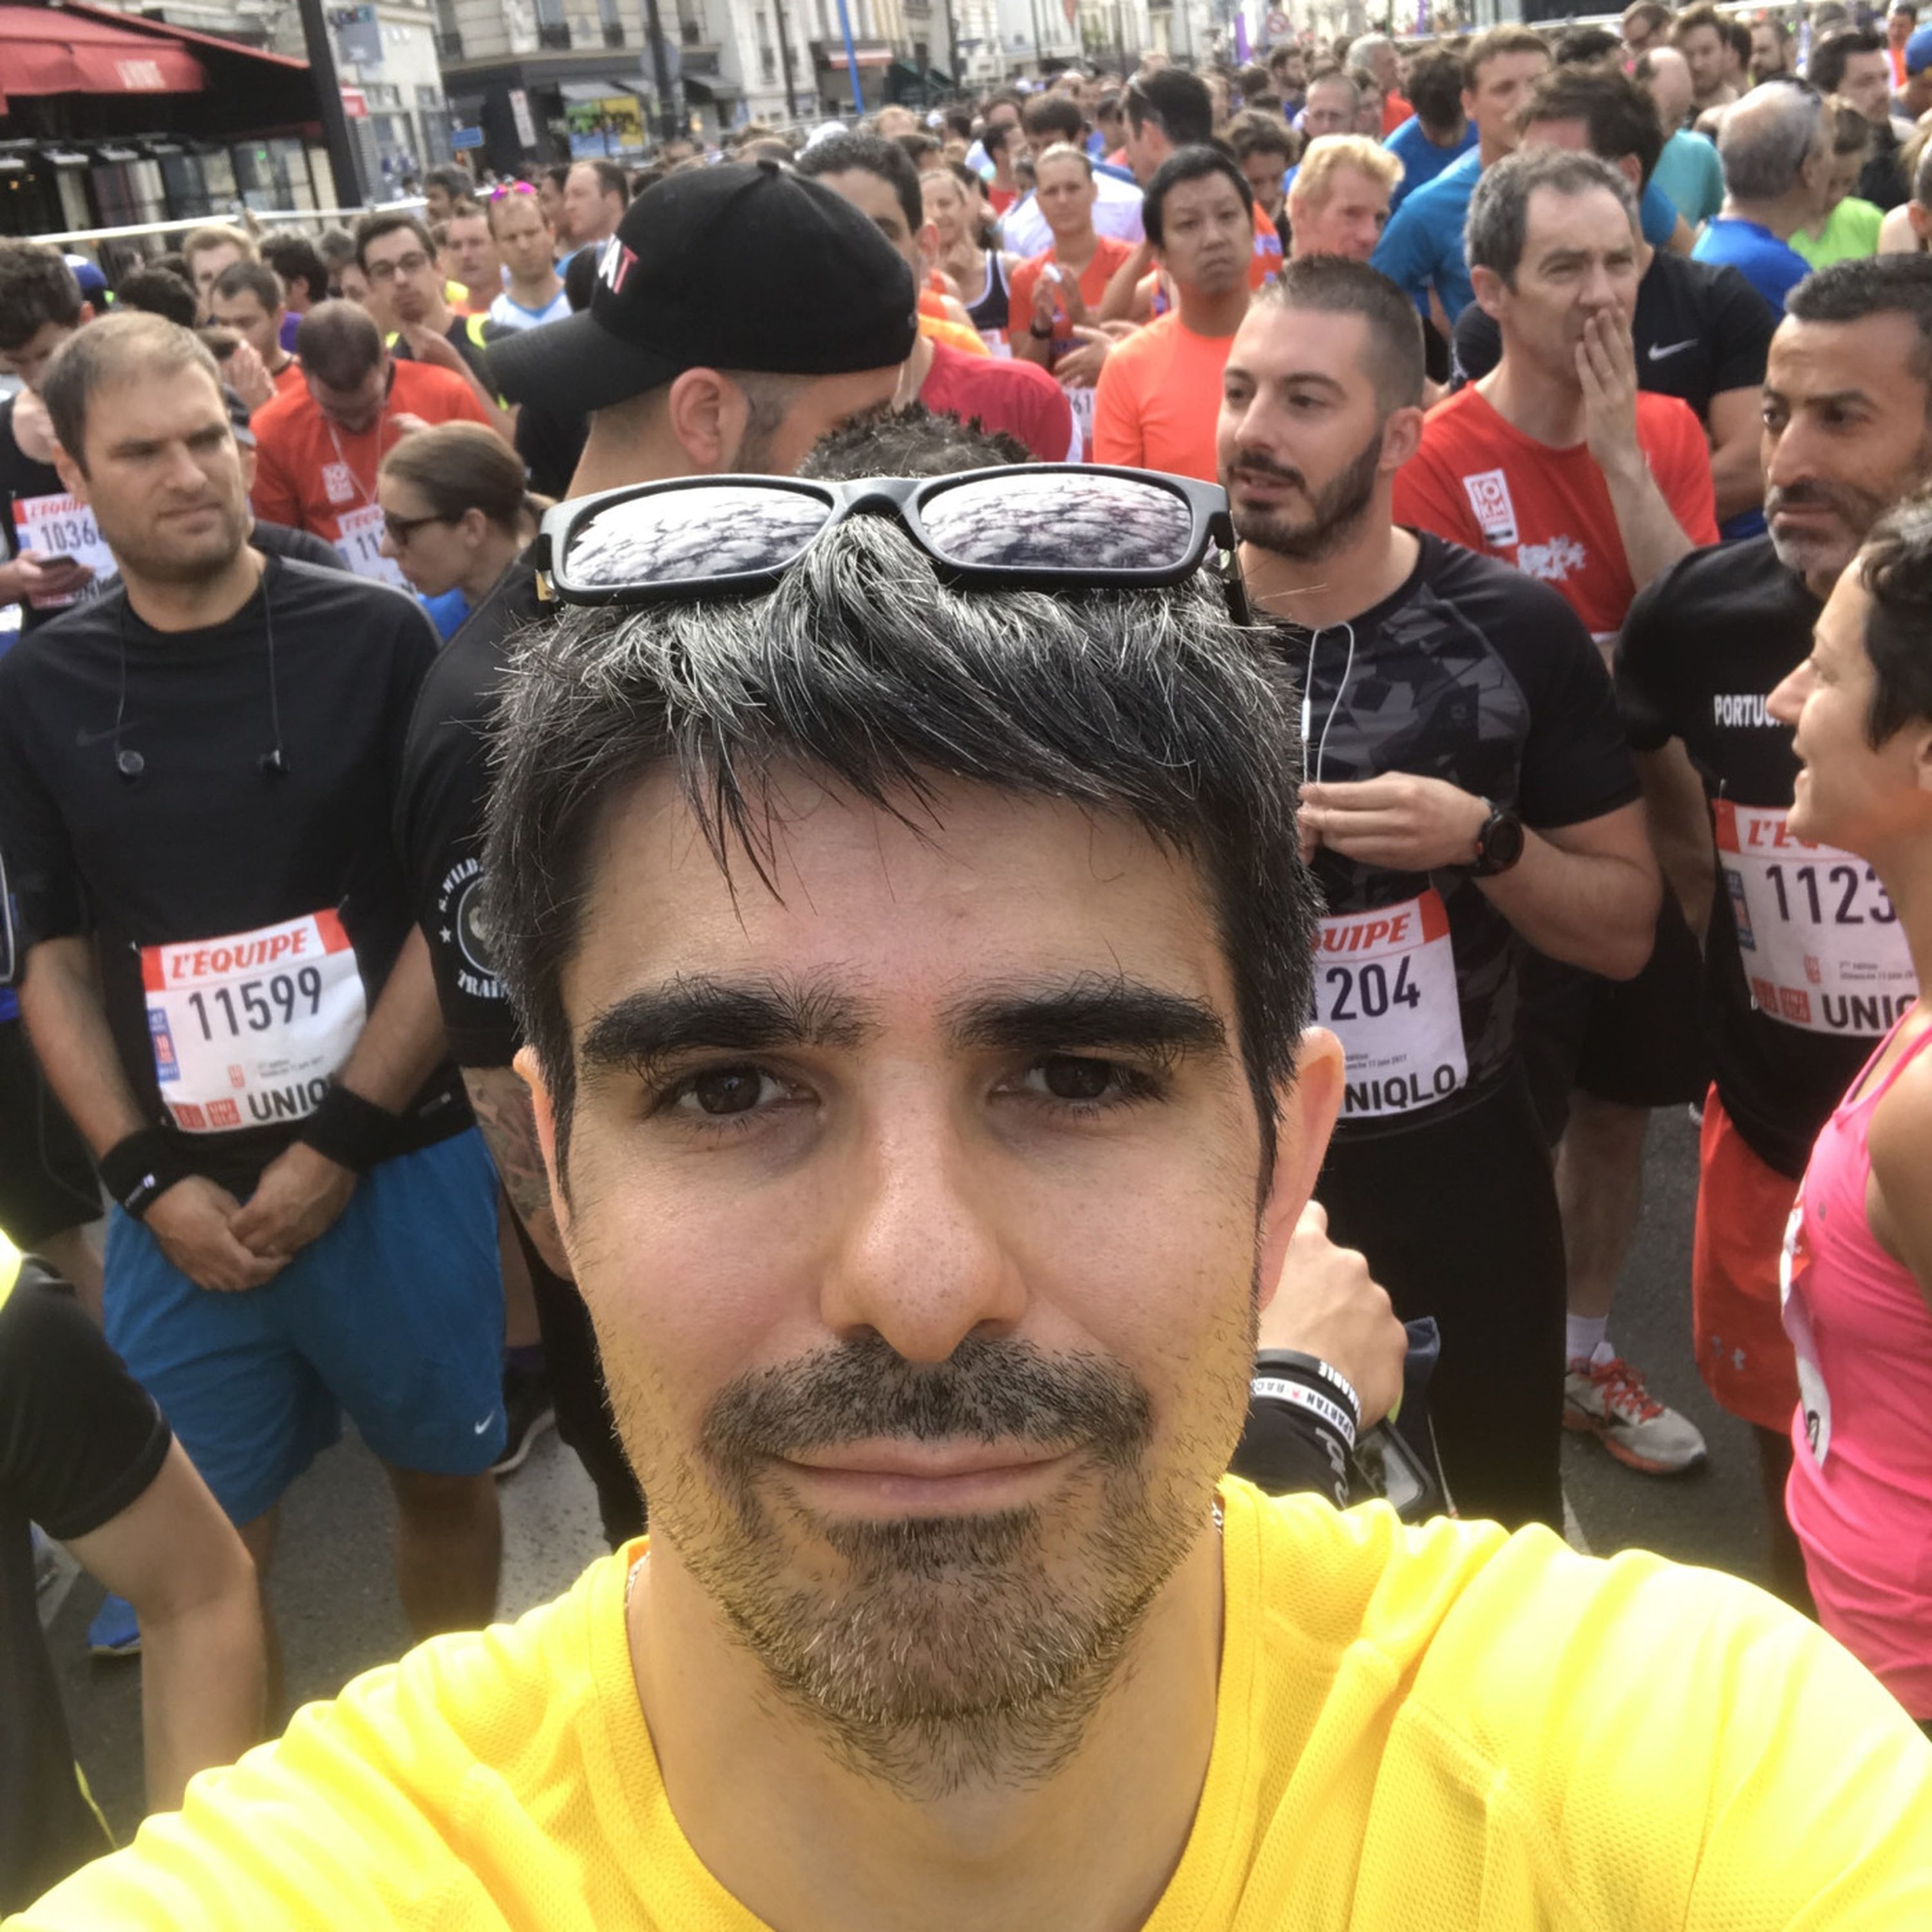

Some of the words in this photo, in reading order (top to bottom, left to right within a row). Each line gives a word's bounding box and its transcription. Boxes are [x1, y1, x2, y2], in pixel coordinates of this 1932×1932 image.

[41, 519, 106, 551] 1036
[1714, 694, 1781, 728] PORTU
[188, 966, 322, 1041] 11599
[1309, 955, 1421, 1021] 204
[1306, 1392, 1353, 1441] SPARTAN
